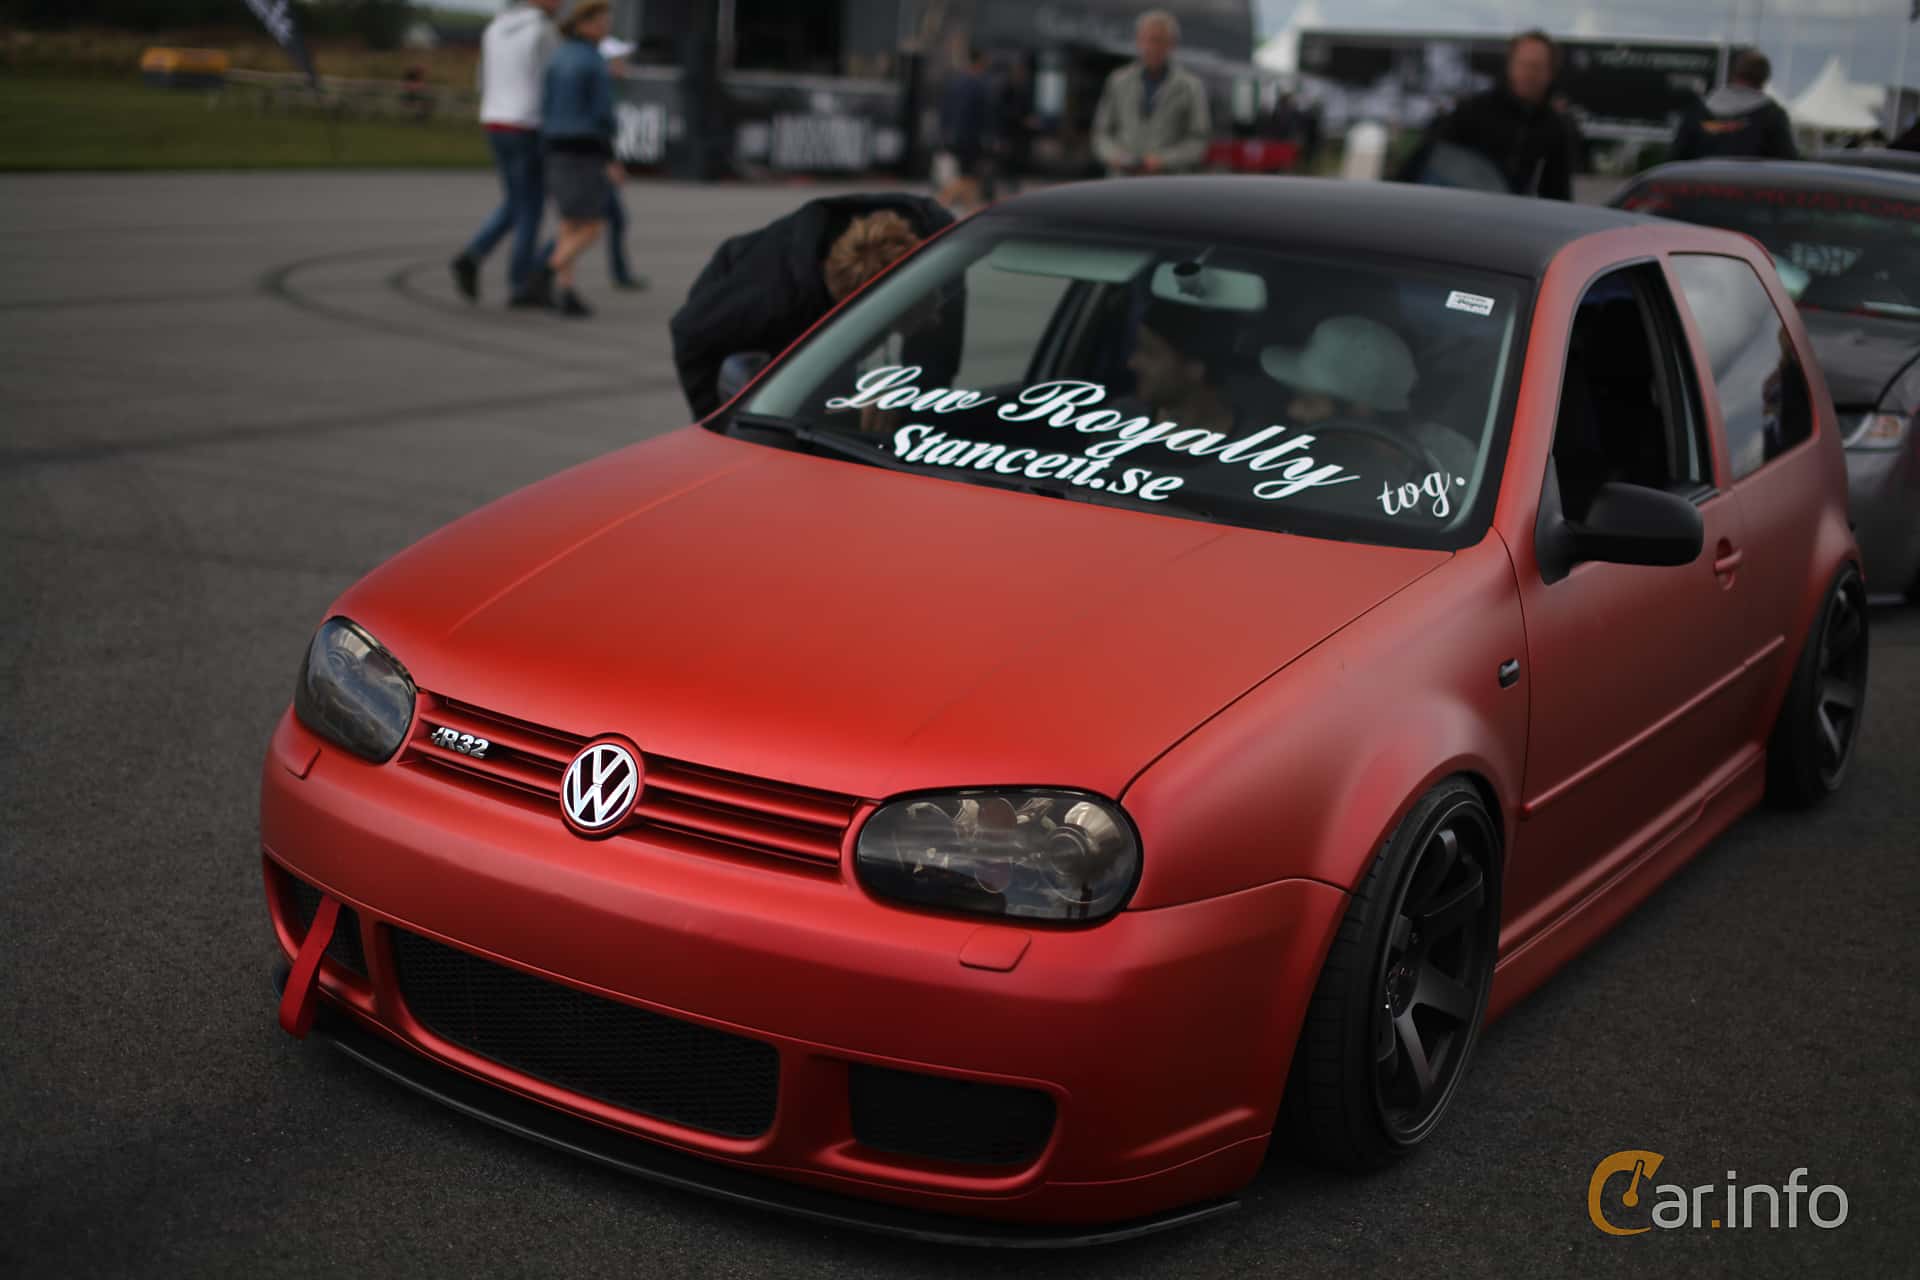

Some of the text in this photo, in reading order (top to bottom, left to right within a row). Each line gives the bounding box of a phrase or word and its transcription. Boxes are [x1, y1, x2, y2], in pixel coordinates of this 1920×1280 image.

[826, 366, 1361, 500] Low Royalty
[431, 726, 489, 759] R32
